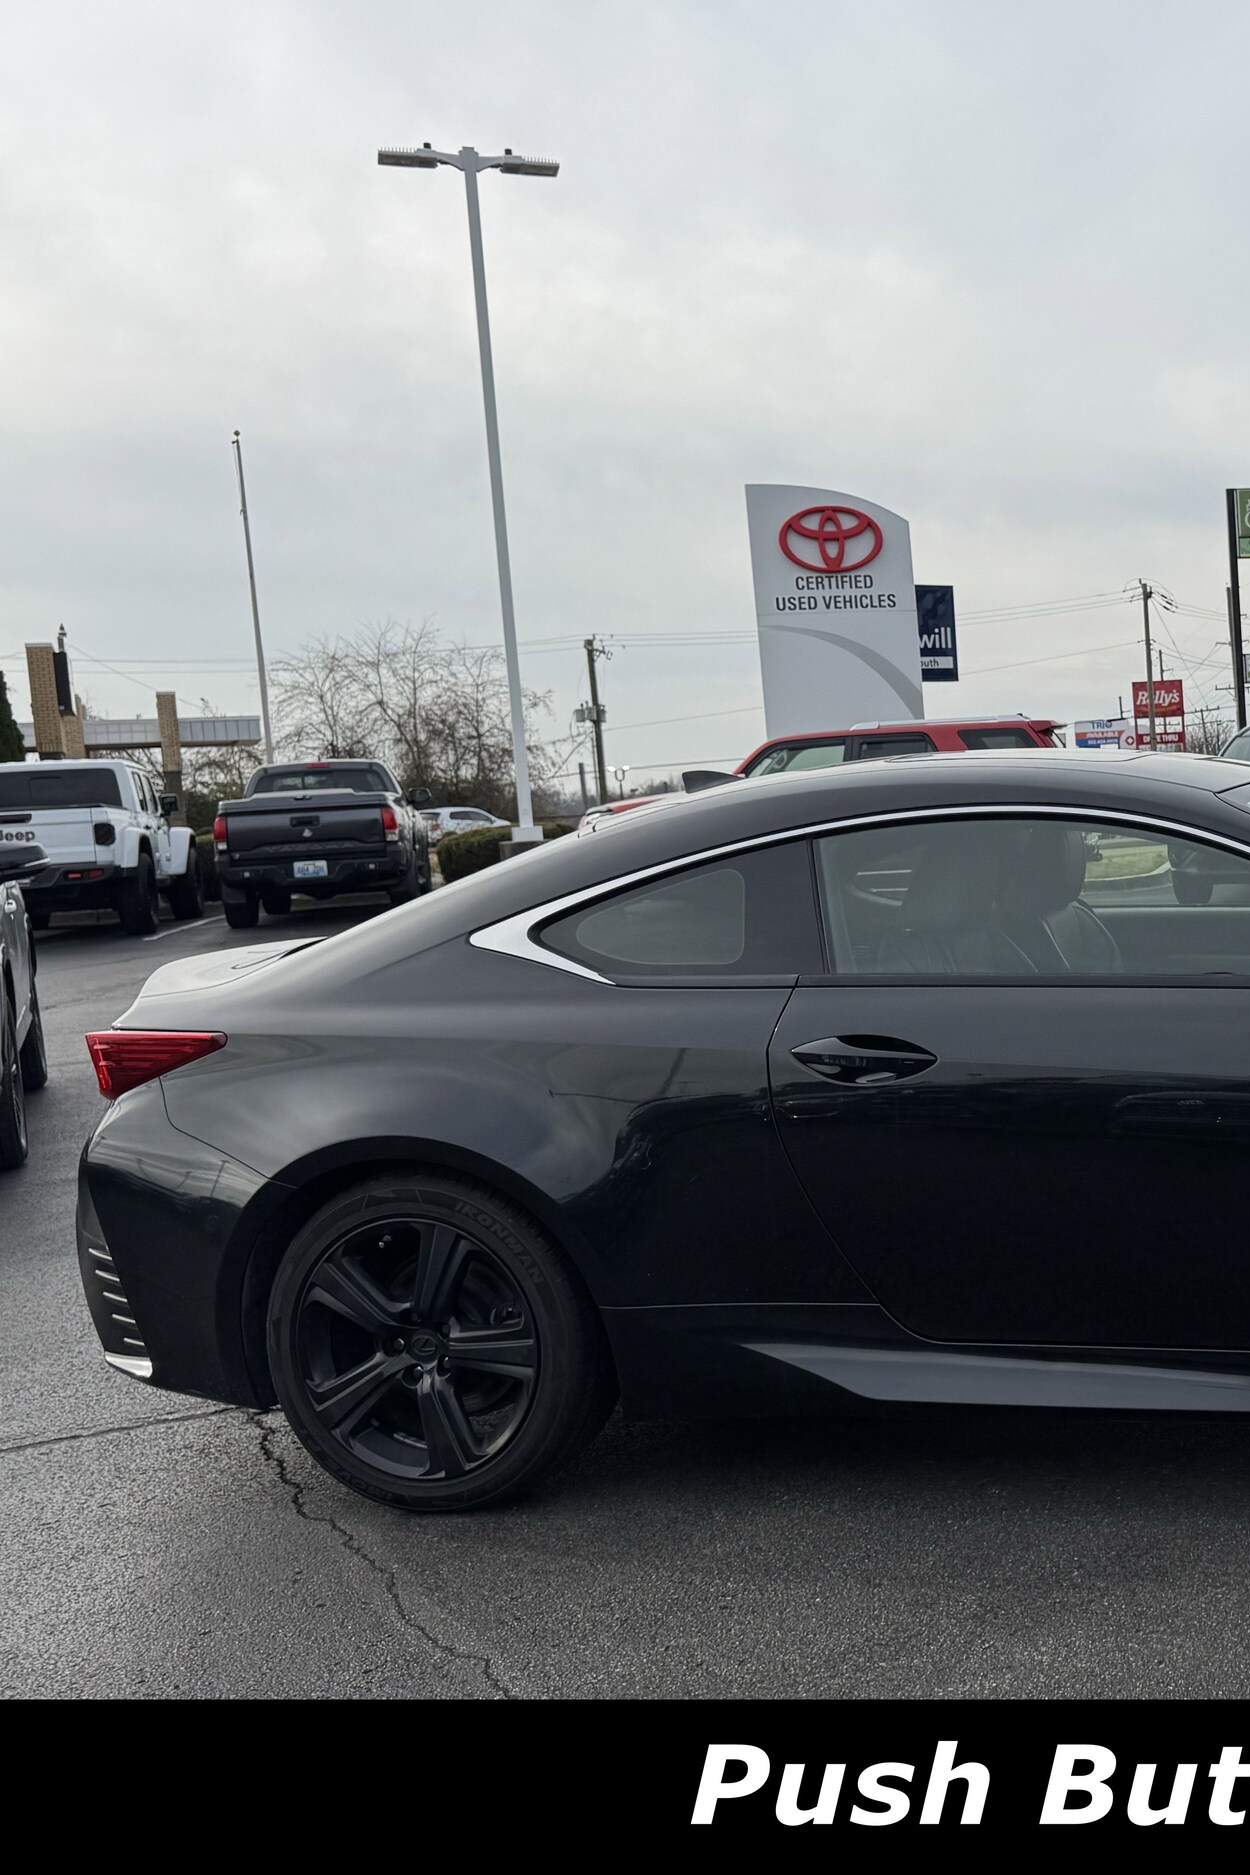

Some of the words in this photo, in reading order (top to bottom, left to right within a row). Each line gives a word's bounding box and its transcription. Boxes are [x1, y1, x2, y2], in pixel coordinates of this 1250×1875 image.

[795, 574, 873, 591] CERTIFIED
[776, 596, 818, 611] USED
[822, 593, 897, 610] VEHICLES
[1136, 689, 1180, 706] Rlly's
[453, 1201, 545, 1284] IRONMAN
